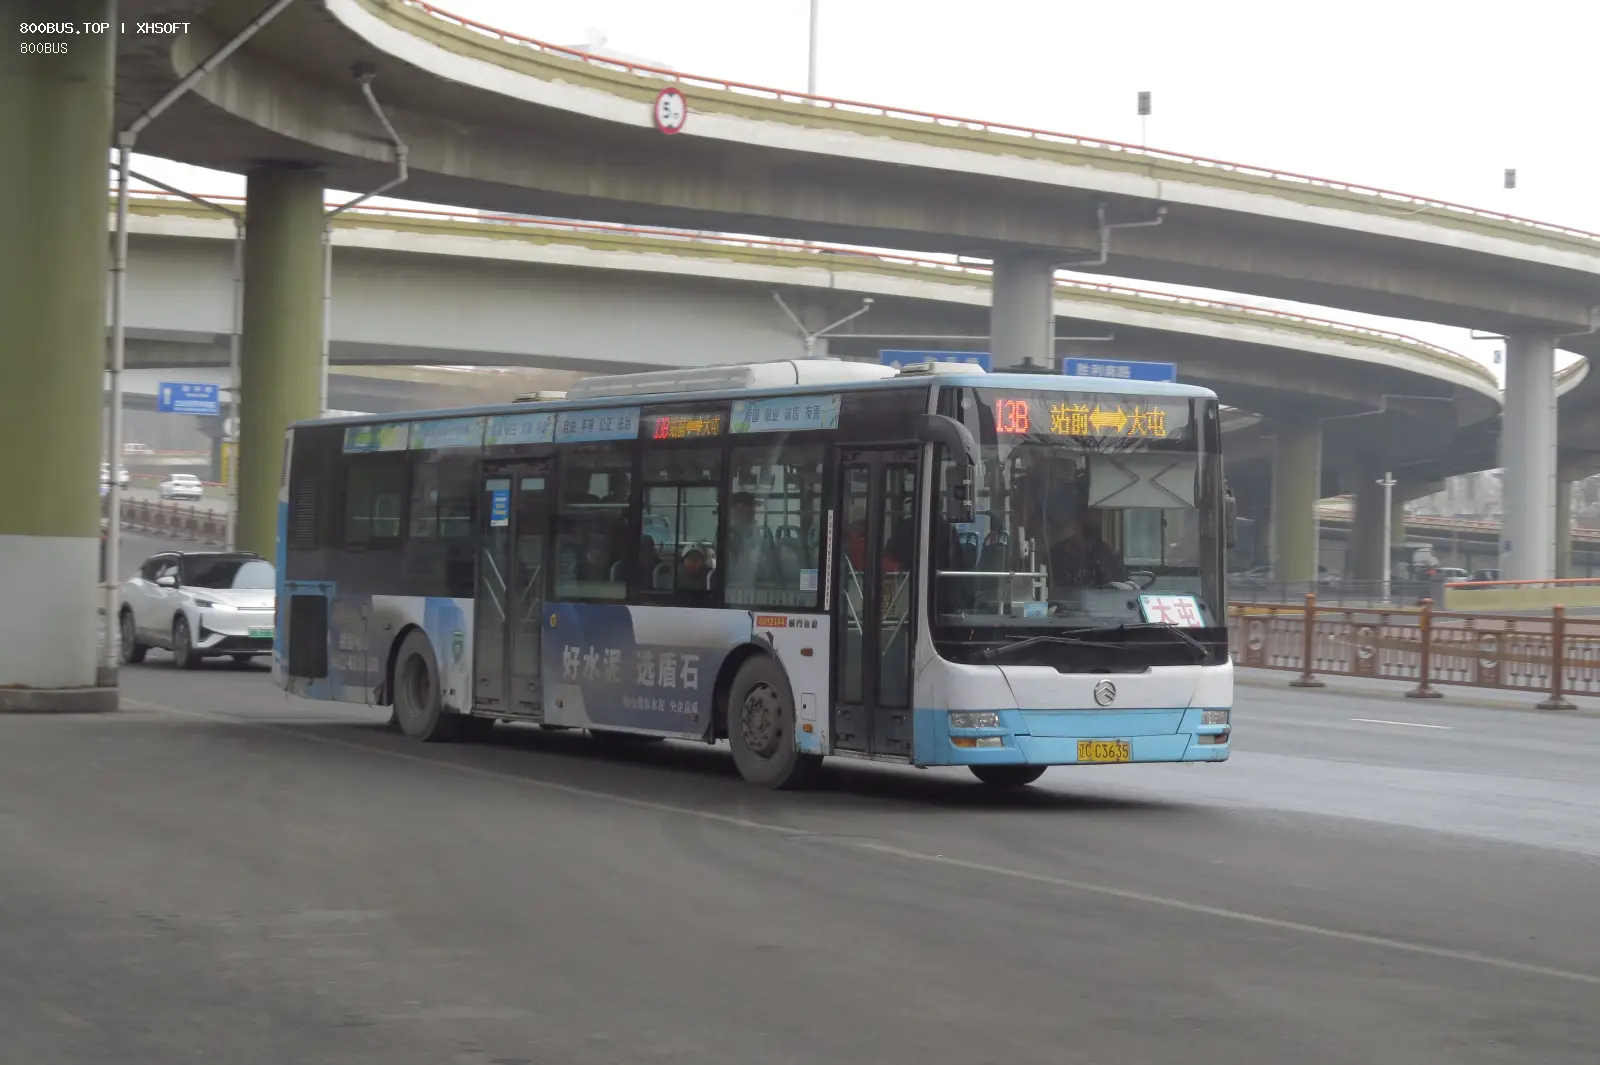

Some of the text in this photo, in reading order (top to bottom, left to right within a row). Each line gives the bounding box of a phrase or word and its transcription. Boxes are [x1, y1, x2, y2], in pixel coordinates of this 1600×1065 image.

[804, 403, 821, 421] 友善
[995, 399, 1167, 437] 13B 站前 大屯
[1151, 597, 1201, 628] 大屯
[562, 644, 701, 691] 好水泥 选盾石
